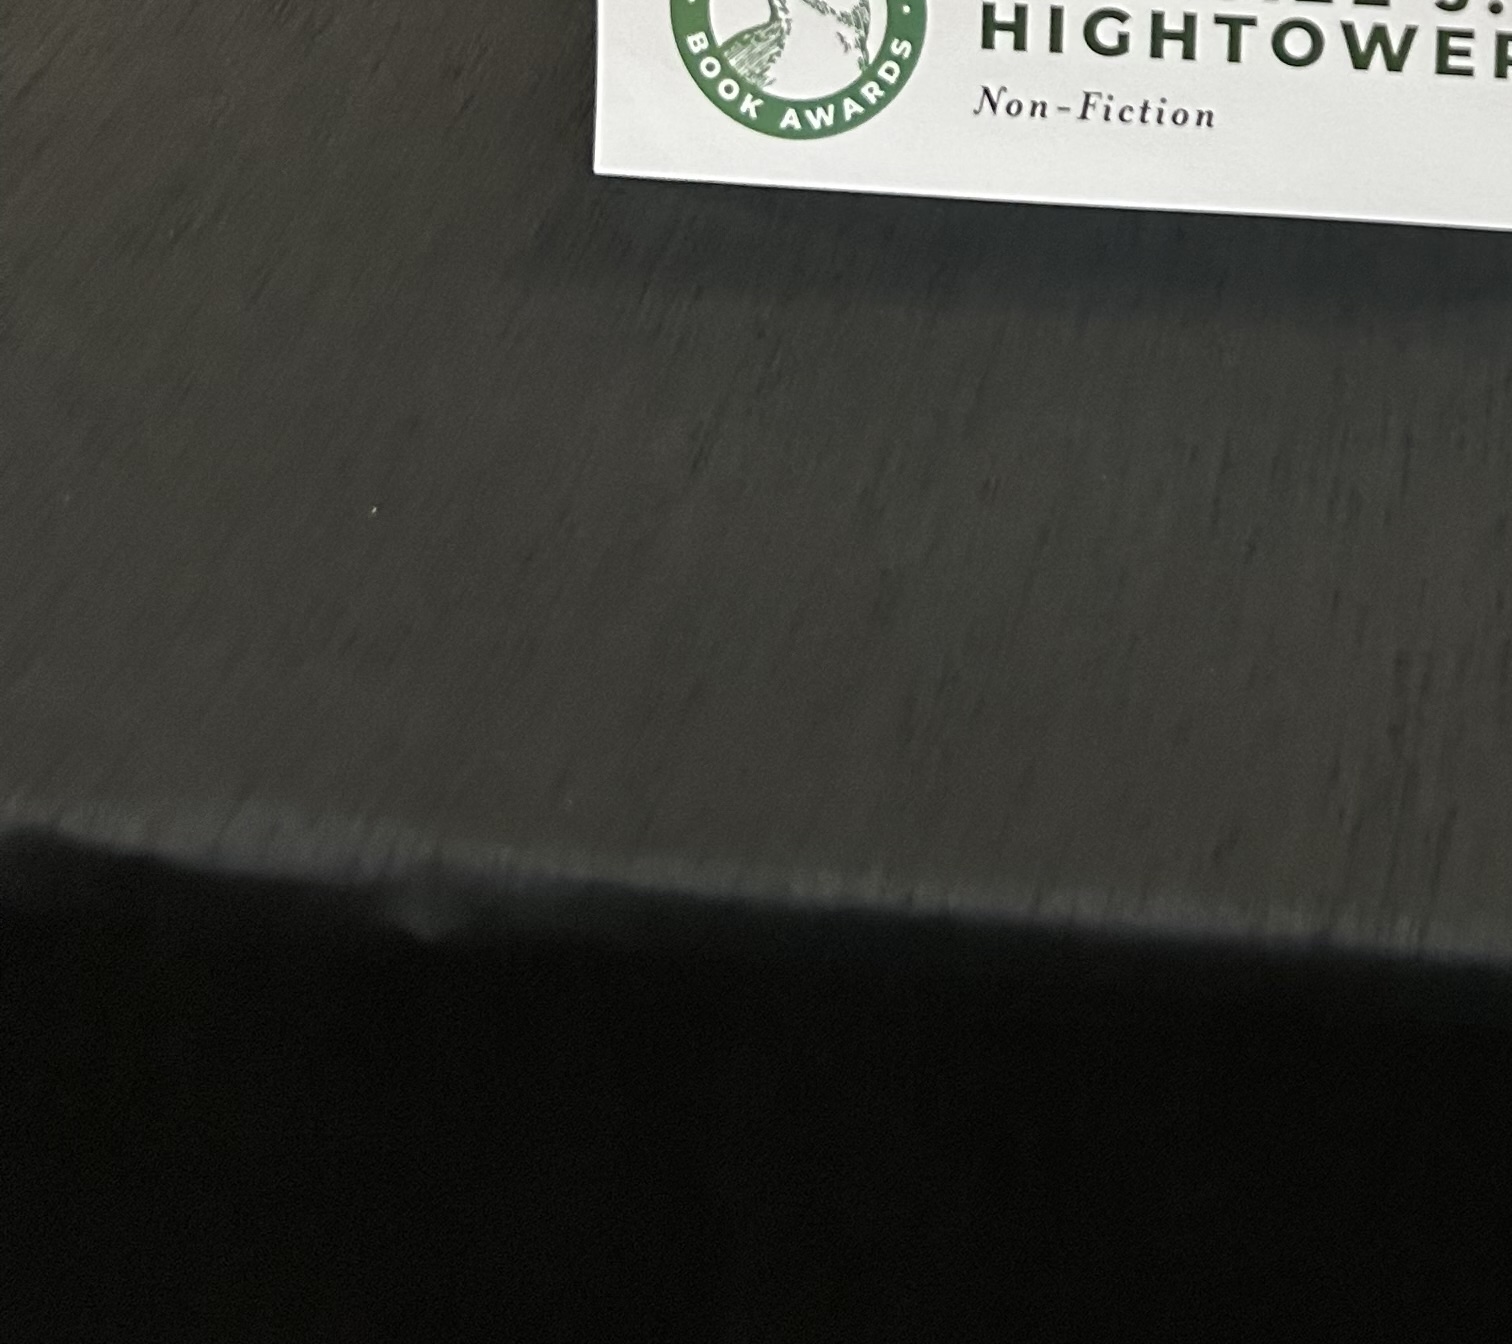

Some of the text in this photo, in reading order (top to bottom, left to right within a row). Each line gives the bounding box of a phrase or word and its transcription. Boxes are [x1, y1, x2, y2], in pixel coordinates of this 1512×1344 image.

[686, 30, 914, 131] BOOK AWARDS
[972, 82, 1217, 129] Non-Fiction
